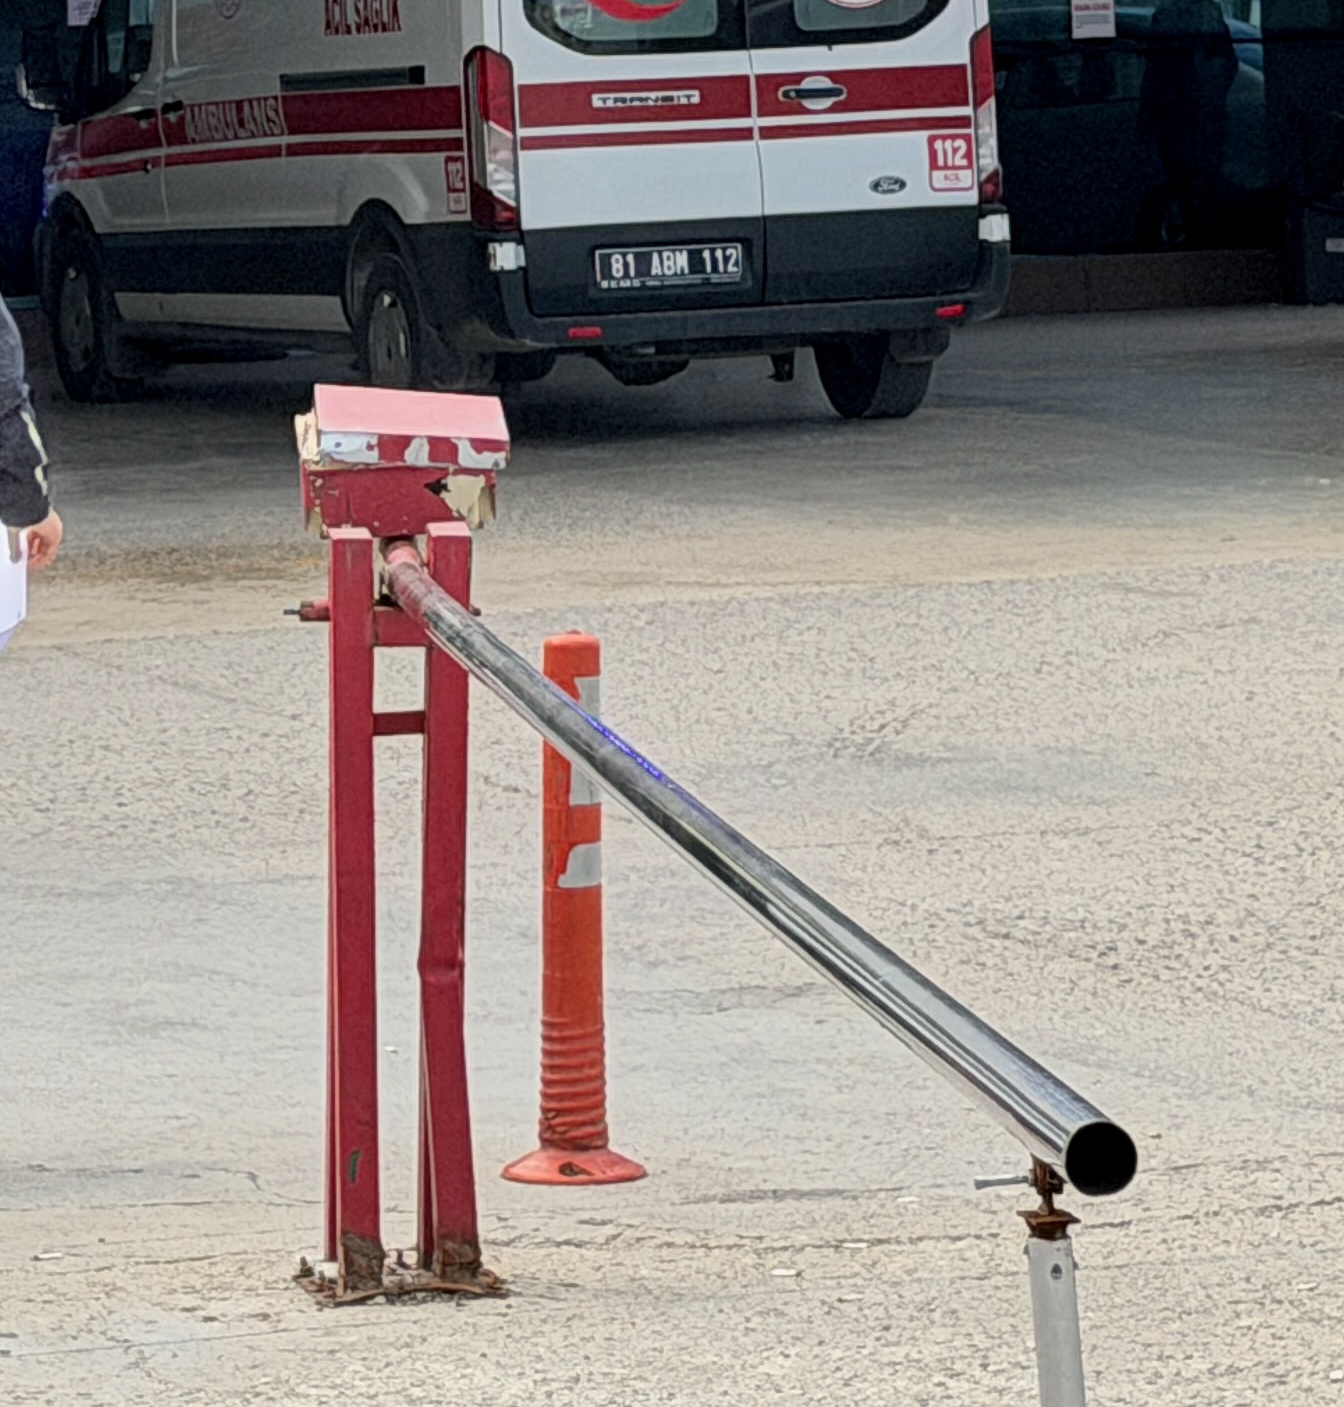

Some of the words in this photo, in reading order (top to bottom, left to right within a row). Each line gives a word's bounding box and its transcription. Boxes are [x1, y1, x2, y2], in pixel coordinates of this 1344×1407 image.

[185, 97, 283, 143] AMBULANS
[934, 138, 968, 167] 112
[875, 177, 903, 192] Ford
[611, 253, 635, 278] 81
[651, 250, 689, 275] ABM
[702, 248, 738, 273] 112
